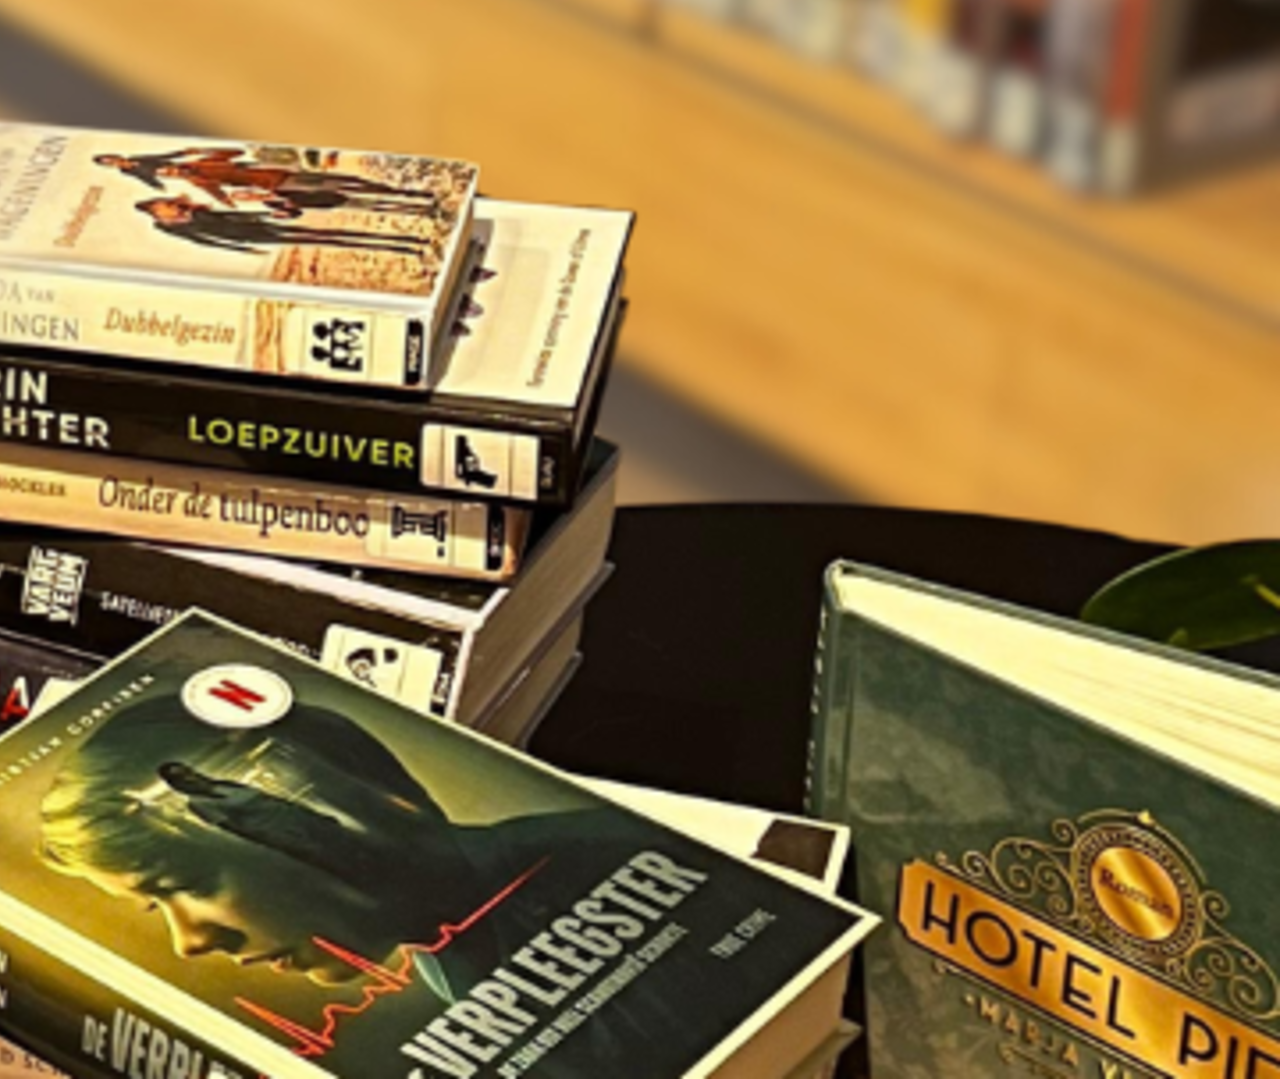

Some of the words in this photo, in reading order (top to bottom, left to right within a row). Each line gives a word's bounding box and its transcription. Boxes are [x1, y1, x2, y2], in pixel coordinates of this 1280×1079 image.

[104, 307, 236, 346] Dubbelgezin
[187, 416, 415, 468] LOEPZUIVER
[98, 474, 176, 514] Onder
[182, 486, 212, 521] de
[219, 489, 371, 538] tulpenboo
[399, 850, 709, 1079] VERPLEEGSTER
[920, 880, 1136, 1040] HOTEL
[81, 1014, 108, 1061] DE
